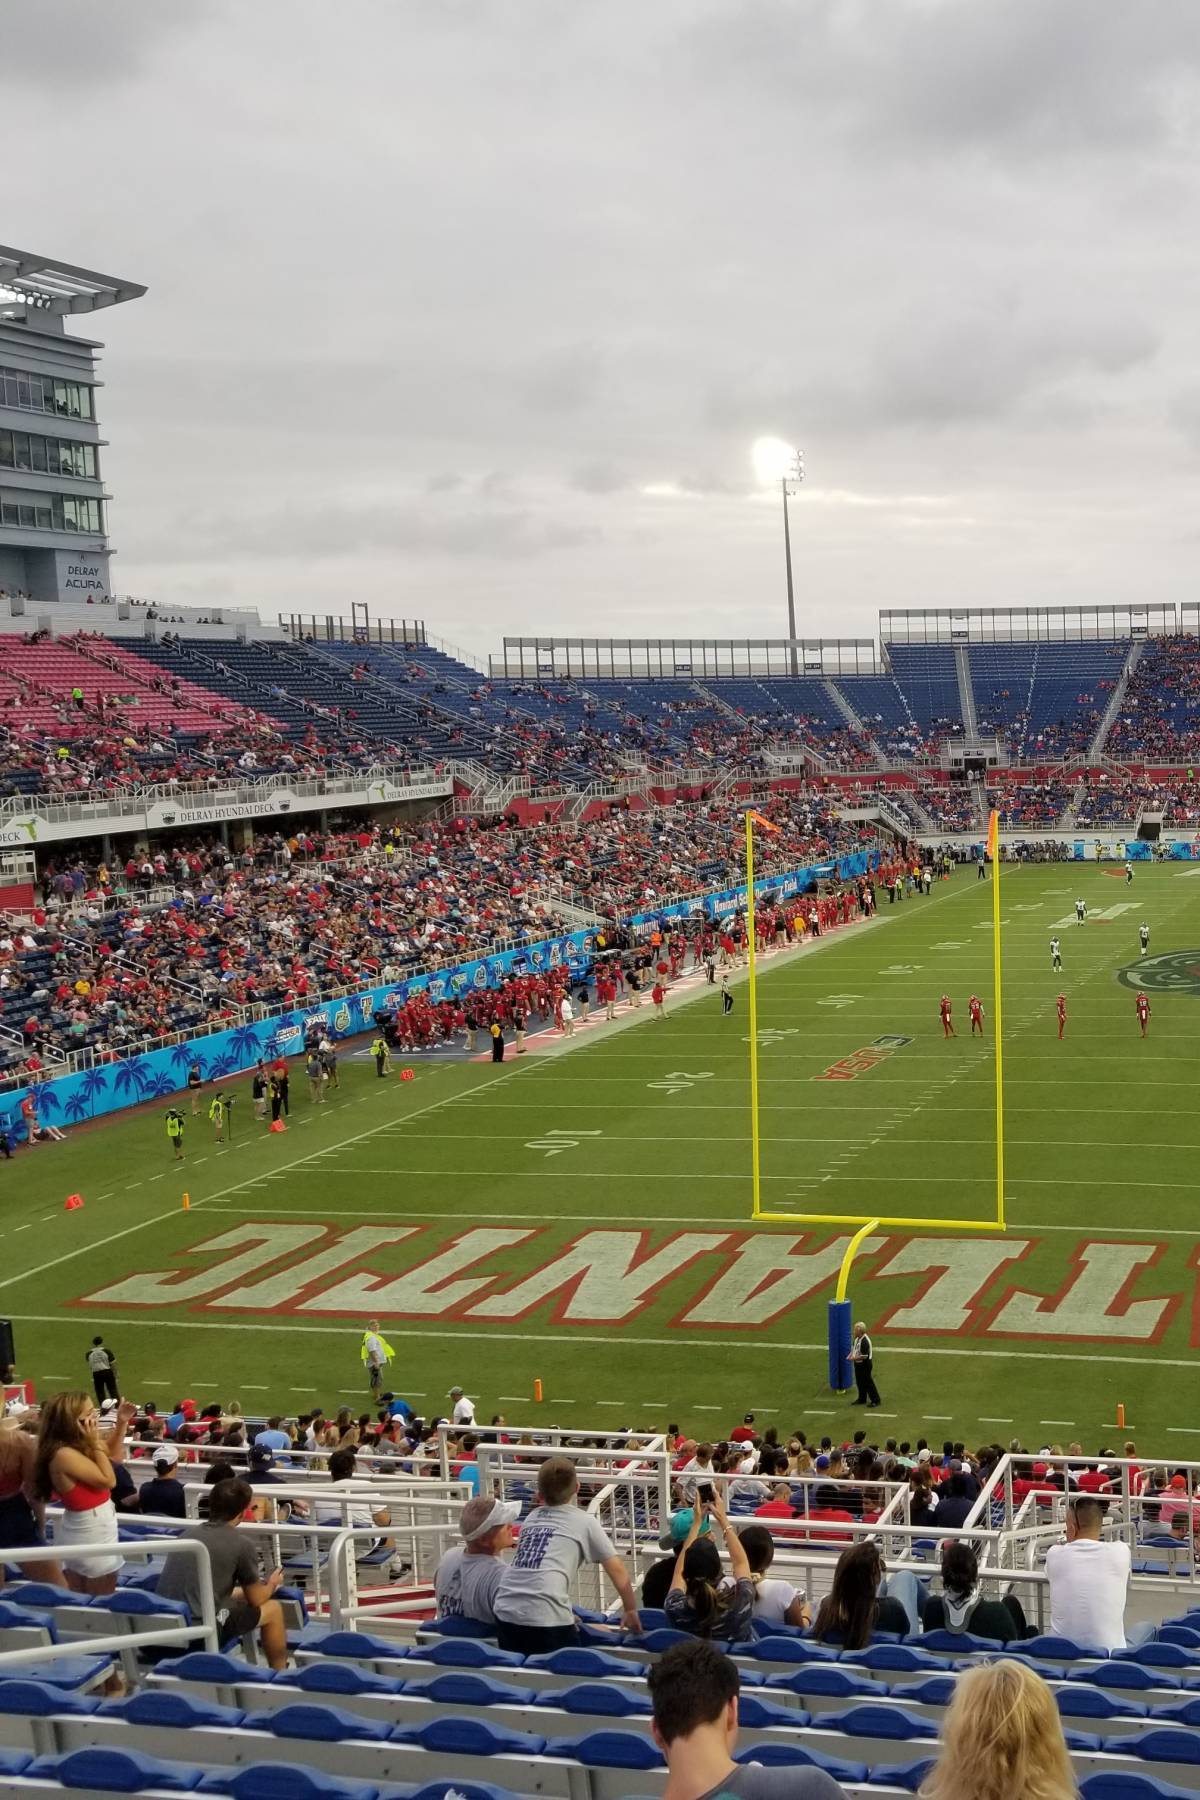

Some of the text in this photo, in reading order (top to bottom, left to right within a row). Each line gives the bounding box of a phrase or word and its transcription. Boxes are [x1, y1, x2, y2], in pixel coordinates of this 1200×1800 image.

[68, 565, 99, 576] DELRAY
[65, 578, 104, 590] ACURA
[180, 803, 275, 823] DELRAY HYUNDAI DECK
[646, 1071, 715, 1089] 20
[523, 1129, 603, 1149] 10
